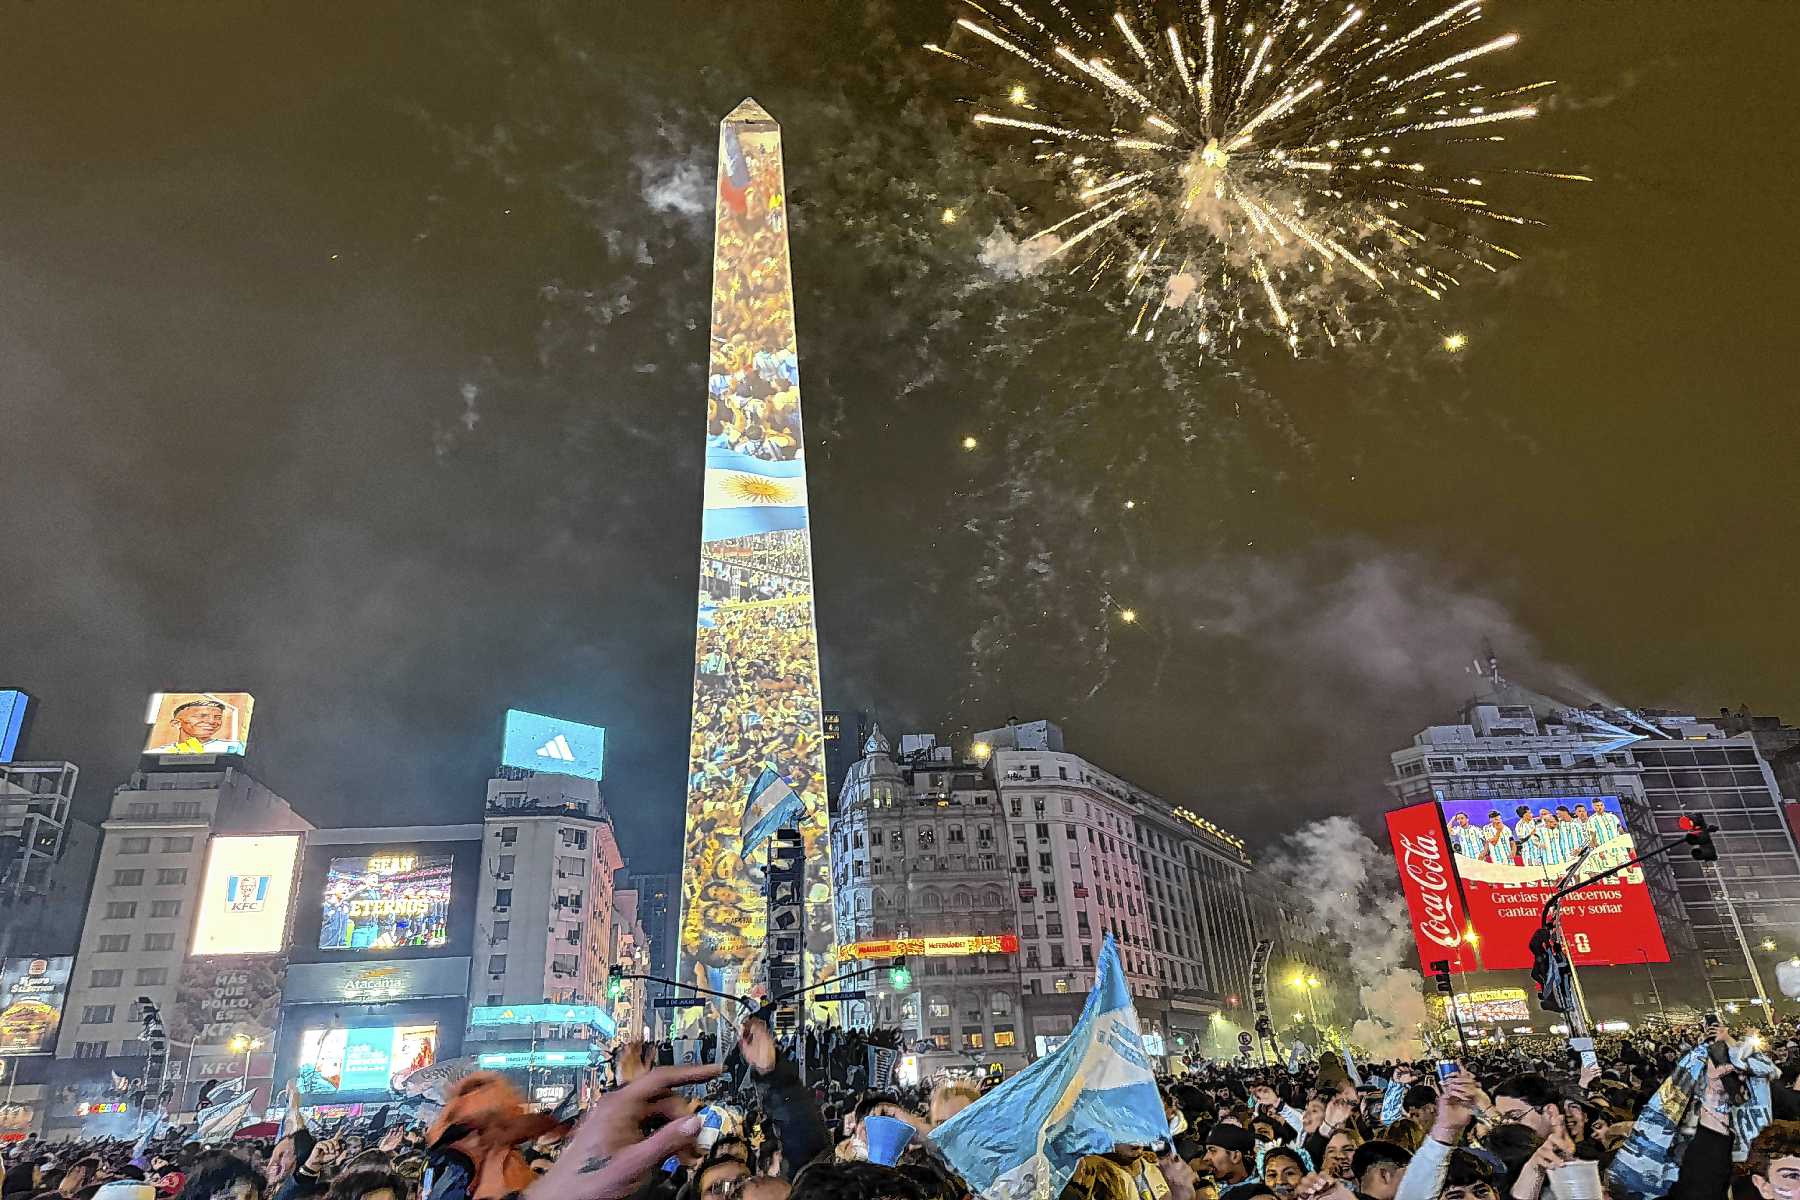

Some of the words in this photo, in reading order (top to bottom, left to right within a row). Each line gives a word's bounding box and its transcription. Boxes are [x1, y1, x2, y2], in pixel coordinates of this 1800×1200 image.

[1400, 833, 1461, 948] Coca-Cola
[1491, 891, 1539, 904] Gracias
[231, 902, 258, 911] KFC
[349, 900, 429, 916] ETERNOS
[1575, 906, 1585, 917] y
[1588, 903, 1623, 915] soñar
[344, 979, 402, 991] Atacama
[214, 986, 246, 998] QUE
[201, 998, 252, 1010] POLLO,
[200, 1062, 240, 1075] KFC
